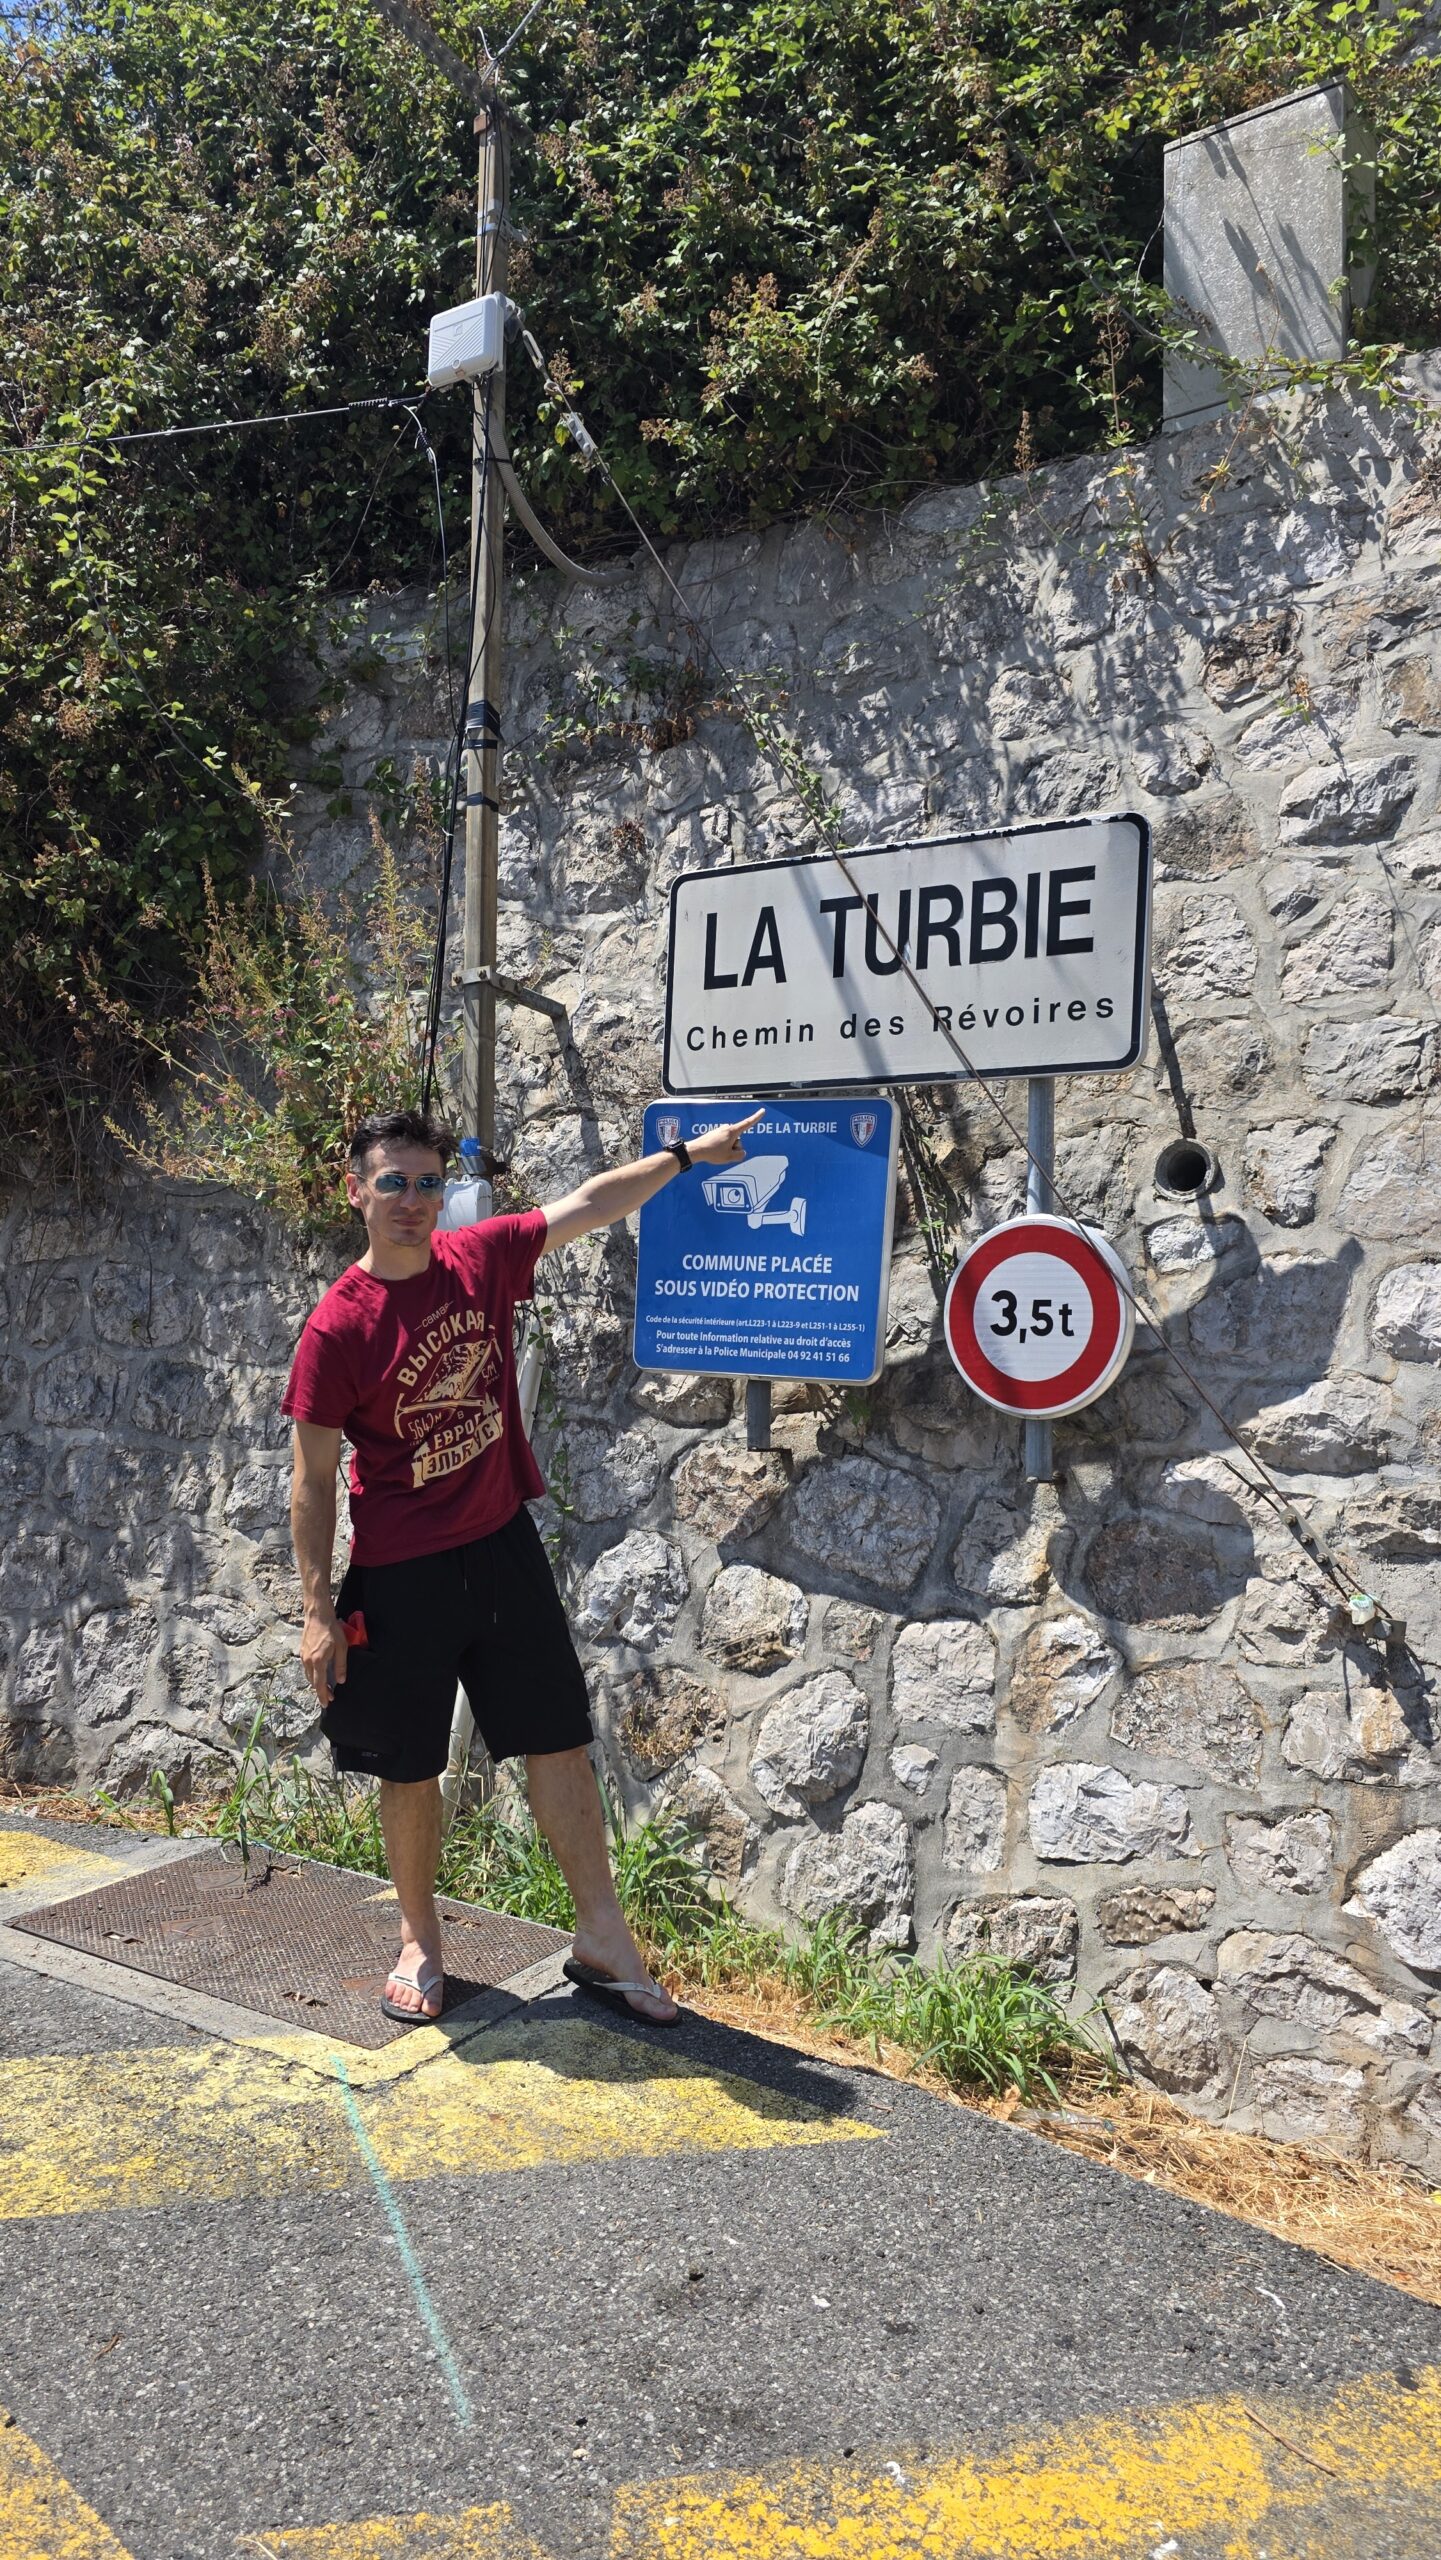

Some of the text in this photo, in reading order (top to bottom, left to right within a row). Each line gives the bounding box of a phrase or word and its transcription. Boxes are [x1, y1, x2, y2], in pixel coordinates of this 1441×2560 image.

[704, 865, 1096, 990] LA TURBIE
[686, 997, 1115, 1051] Chemin des Révoires
[692, 1121, 838, 1135] COME DE LA TURBIE
[682, 1253, 833, 1273] COMMUNE PLACÉE
[655, 1278, 860, 1302] SOUS VIDÉO PROTECTION
[645, 1315, 662, 1323] Code
[663, 1315, 670, 1323] de
[672, 1316, 678, 1324] la
[678, 1316, 703, 1325] sécurité
[772, 1320, 777, 1328] à
[833, 1323, 838, 1331] à
[990, 1289, 1075, 1344] 3,5t
[397, 1309, 485, 1387] ВЫСОКАЯ
[656, 1330, 675, 1340] Pour
[677, 1331, 699, 1341] toute
[750, 1333, 782, 1345] relative
[784, 1337, 794, 1345] au
[796, 1336, 817, 1347] droit
[819, 1337, 851, 1348] d'accès
[656, 1343, 850, 1363] S'adresser à la Police Municipale 04 92 41 51 66
